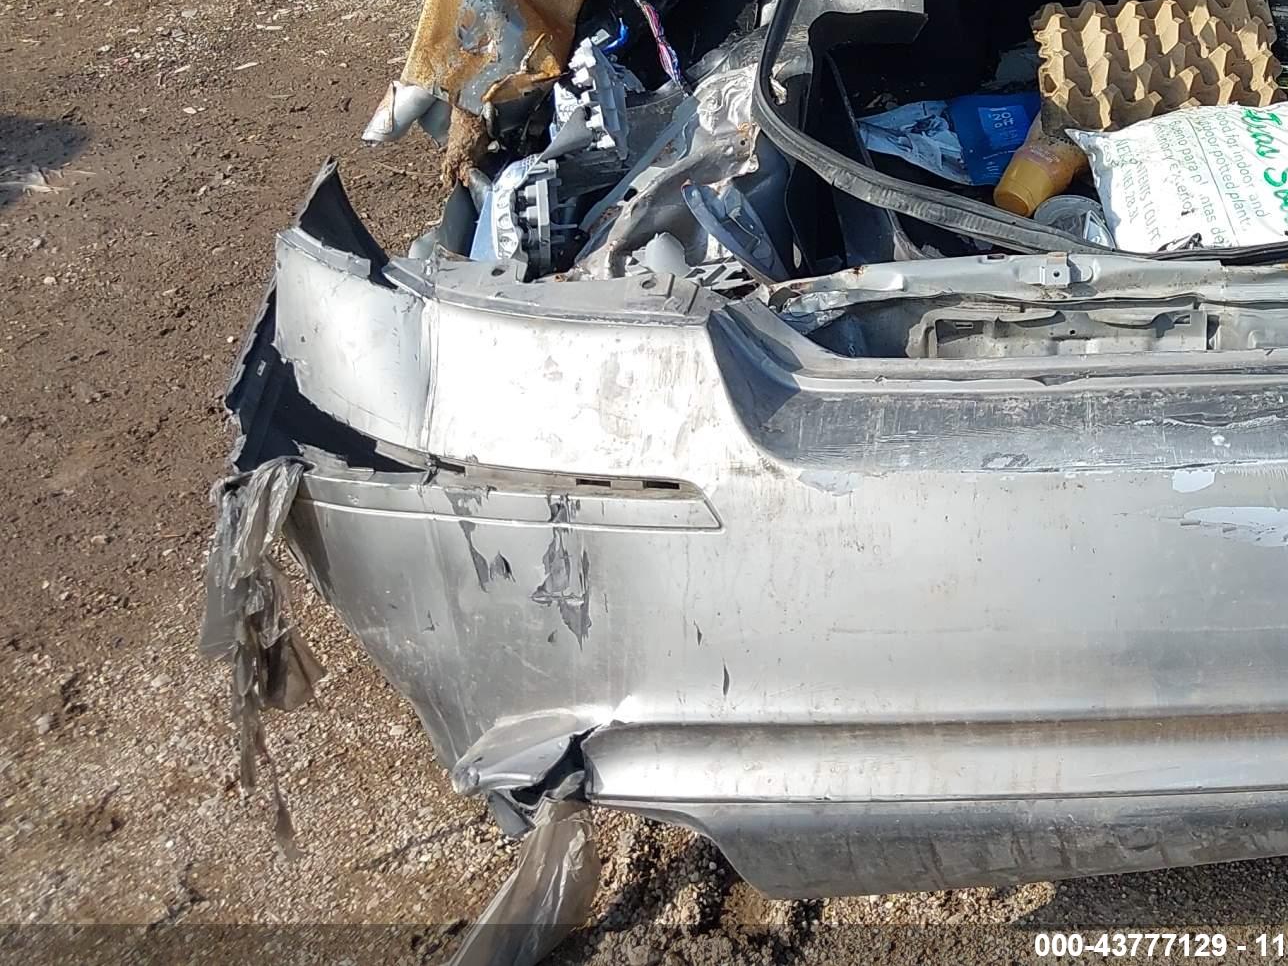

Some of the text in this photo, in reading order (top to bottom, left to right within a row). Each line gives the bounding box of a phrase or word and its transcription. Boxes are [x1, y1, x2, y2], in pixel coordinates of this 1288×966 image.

[1178, 146, 1199, 172] para
[1190, 171, 1217, 224] plntas
[1211, 149, 1236, 190] potted
[1249, 193, 1271, 219] and
